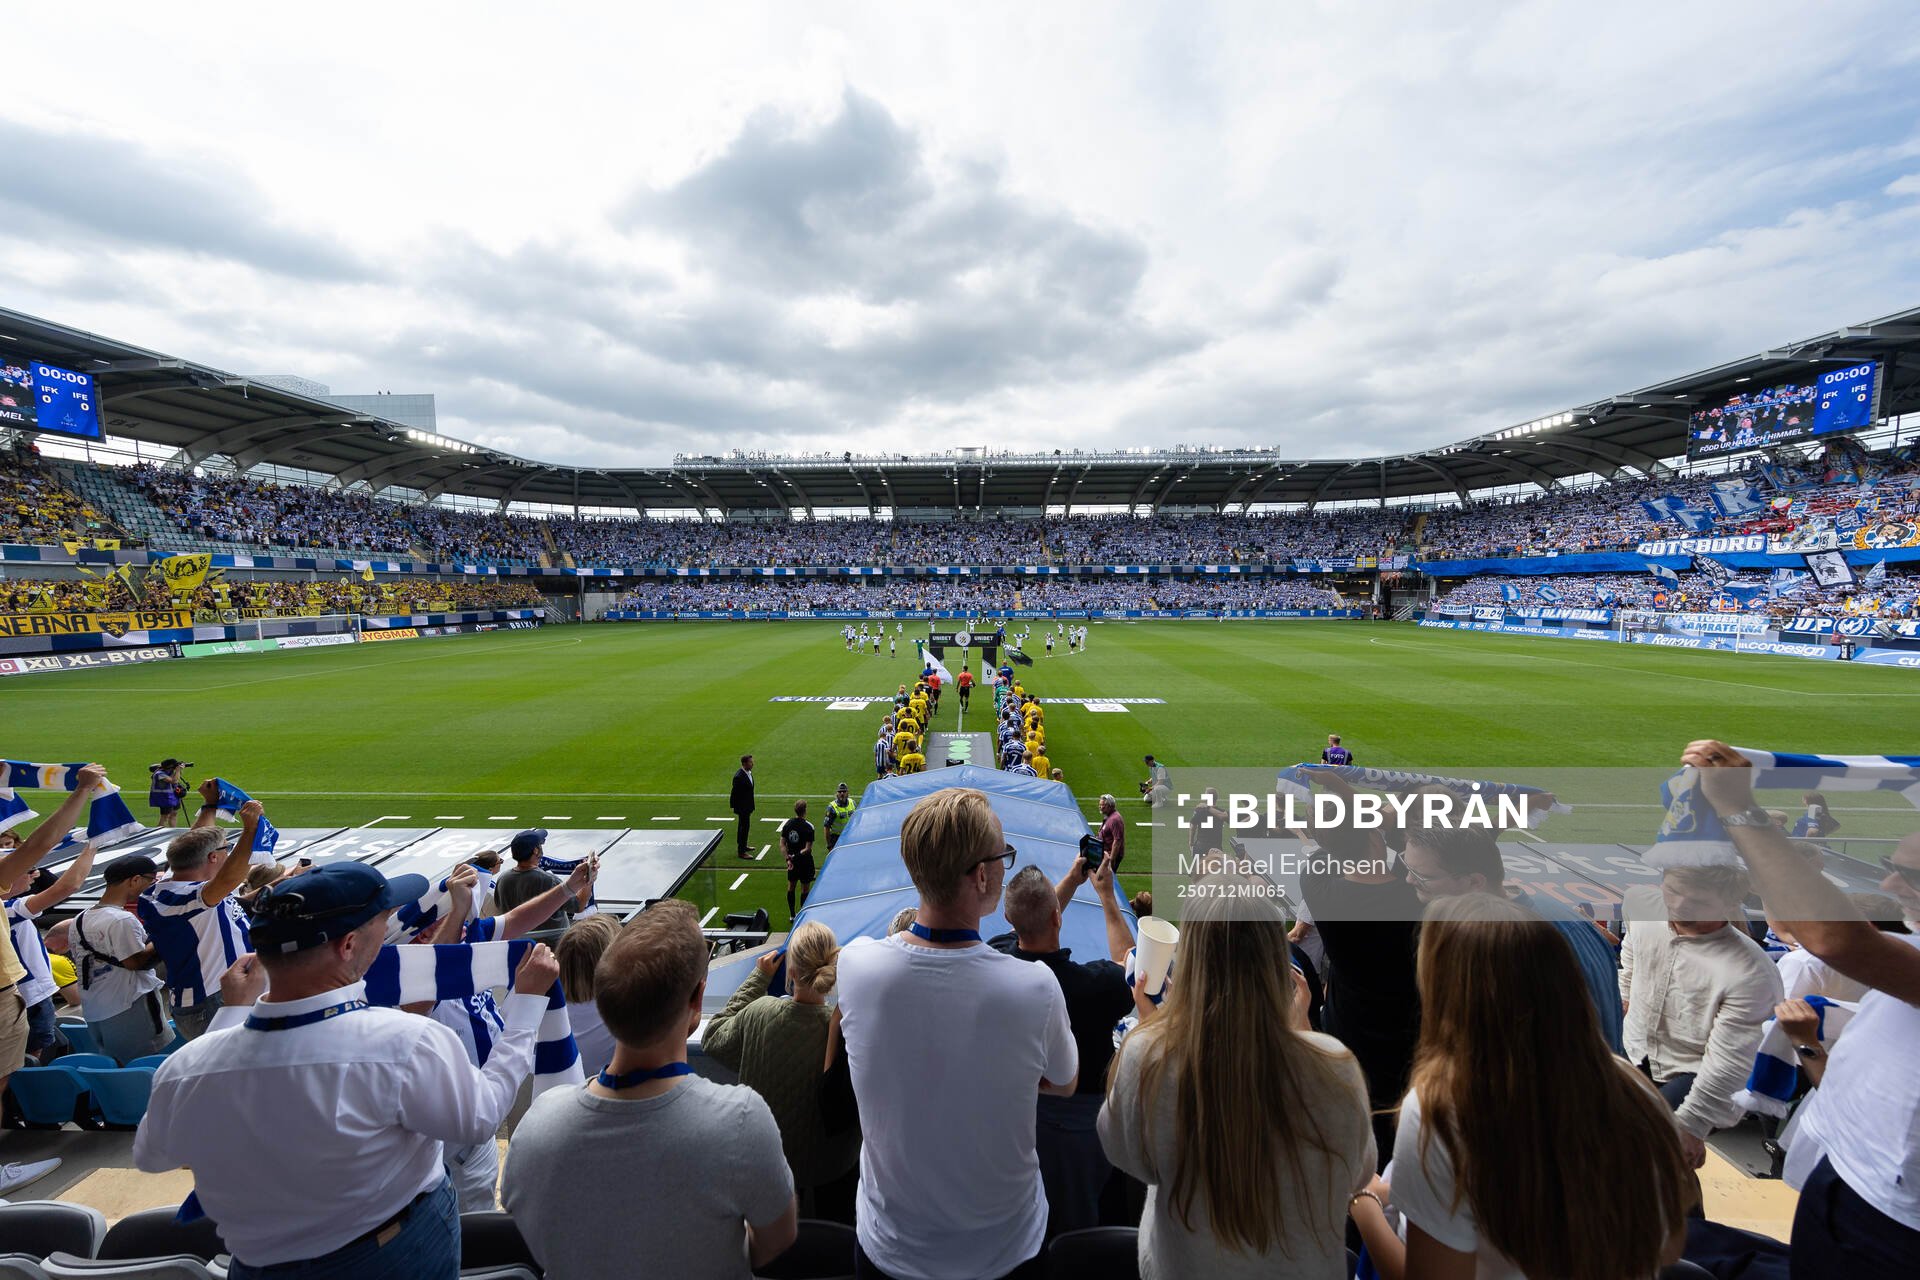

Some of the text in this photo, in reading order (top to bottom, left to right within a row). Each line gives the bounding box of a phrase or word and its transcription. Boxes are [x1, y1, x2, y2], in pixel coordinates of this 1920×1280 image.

[38, 366, 87, 386] 00:00
[1824, 366, 1870, 384] 00:00
[41, 385, 59, 395] IFK
[1851, 384, 1868, 392] IFE
[42, 394, 52, 404] 0
[72, 392, 88, 401] IFE
[1822, 390, 1838, 400] IFK
[1857, 394, 1866, 402] 0
[80, 402, 90, 411] 0
[1822, 401, 1830, 409] 0
[1720, 441, 1732, 449] UR
[1746, 436, 1766, 444] OCH
[1768, 428, 1803, 440] HIMMEL
[1636, 535, 1764, 556] GÖTEBORG
[134, 612, 184, 629] 1991
[1420, 620, 1456, 628] Interbus
[358, 629, 416, 642] BYGGMAX
[1652, 634, 1700, 647] Renova
[65, 648, 170, 667] XL-BYGG
